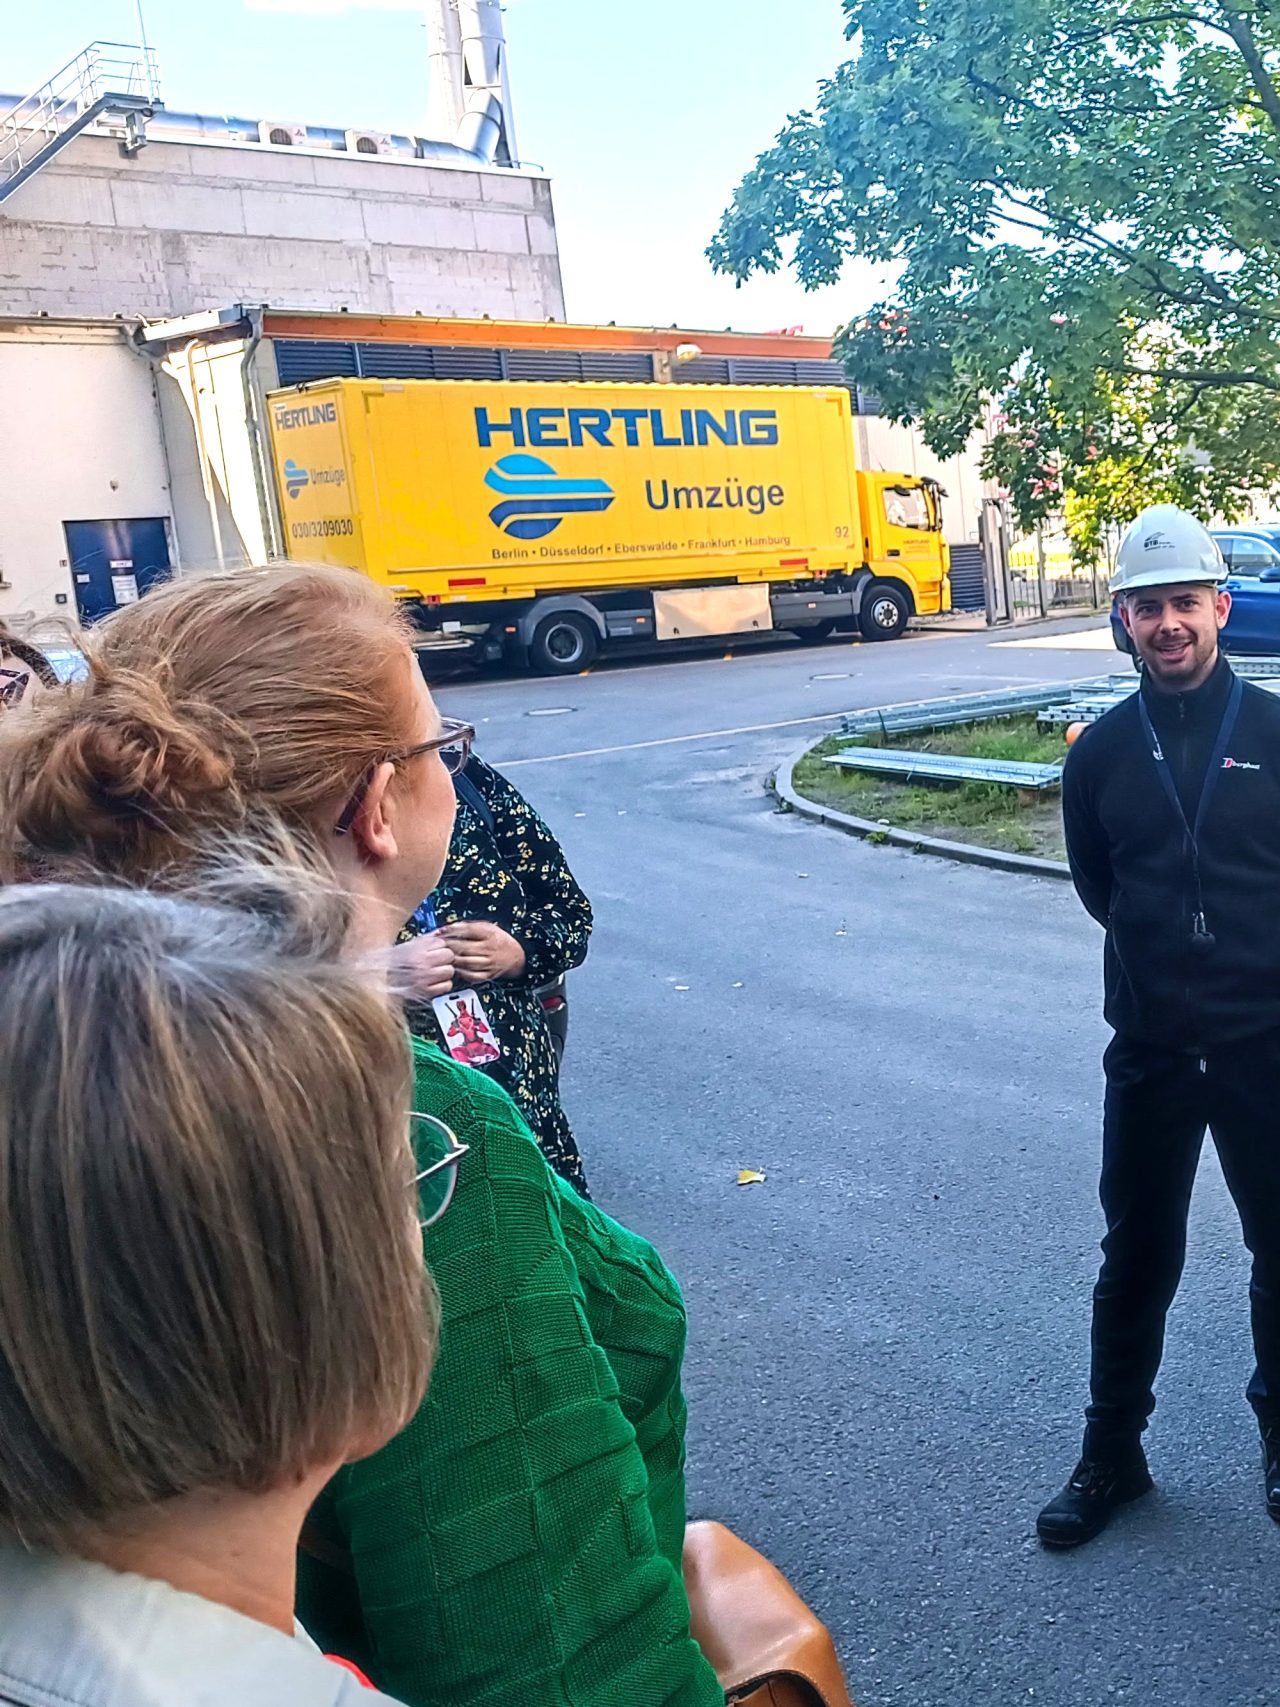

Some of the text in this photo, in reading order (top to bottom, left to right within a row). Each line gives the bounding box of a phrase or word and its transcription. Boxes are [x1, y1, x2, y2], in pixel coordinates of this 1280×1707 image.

[274, 402, 337, 431] HERTLING
[474, 406, 779, 447] HERTLING
[310, 465, 346, 487] Umzüge
[645, 477, 785, 514] Umzüge
[292, 519, 354, 538] 030/3209030
[834, 526, 849, 538] 92
[491, 535, 791, 559] Berlin Düsseldorf Eberswalde Frankfurt Hamburg
